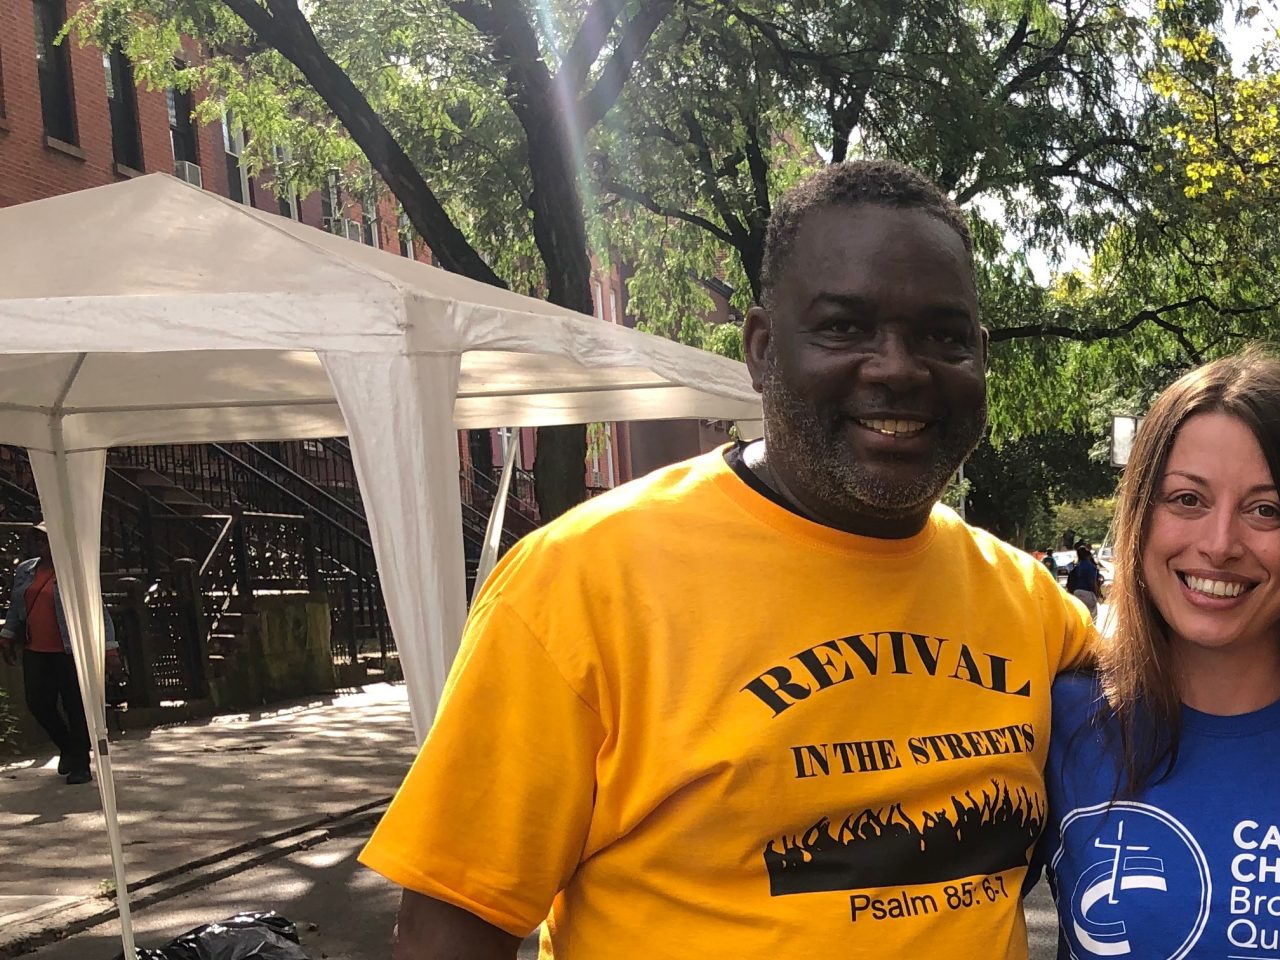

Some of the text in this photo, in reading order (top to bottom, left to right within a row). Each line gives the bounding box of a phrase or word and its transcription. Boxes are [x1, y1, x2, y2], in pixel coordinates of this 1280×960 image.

[740, 632, 1031, 718] REVIVAL
[789, 724, 1035, 778] IN THE STREETS
[851, 876, 1008, 922] Psalm 85: 6-7
